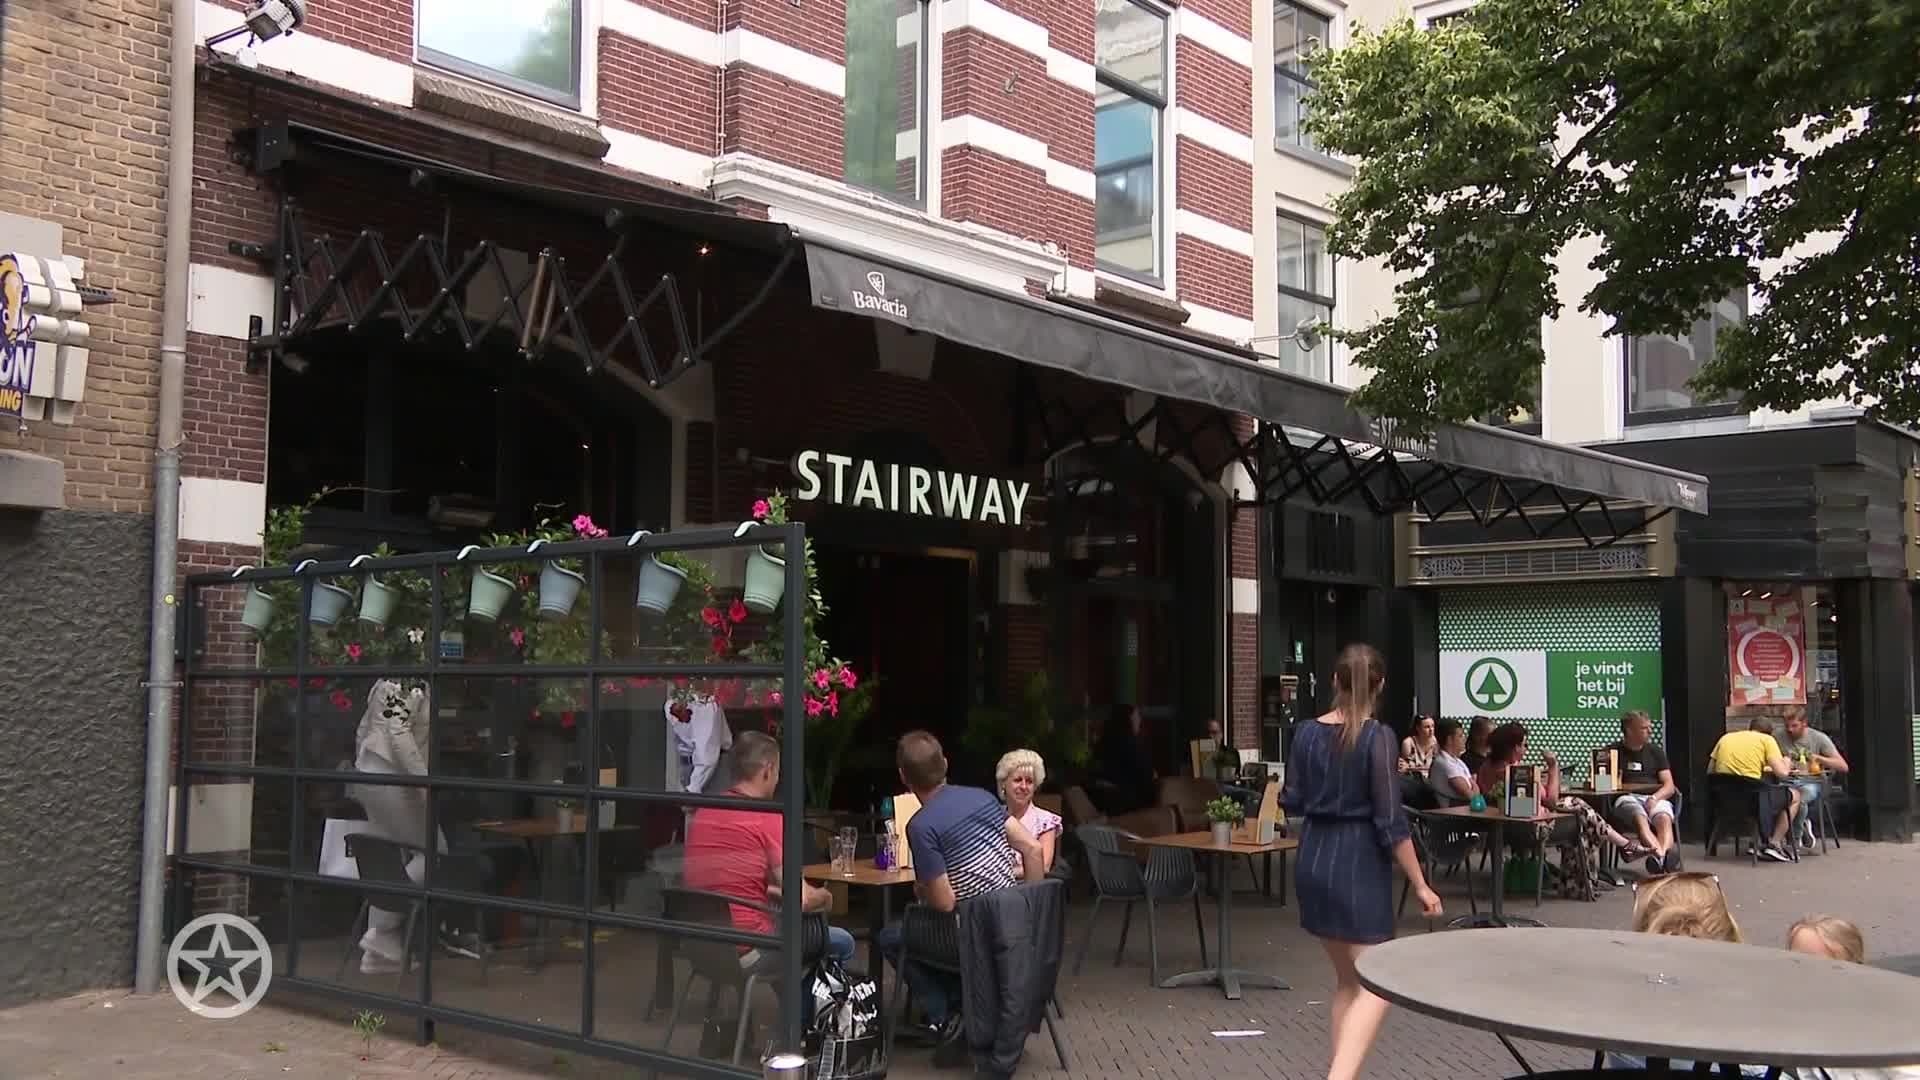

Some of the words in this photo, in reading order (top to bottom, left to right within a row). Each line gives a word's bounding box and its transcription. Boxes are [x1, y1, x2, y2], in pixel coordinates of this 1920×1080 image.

[852, 291, 908, 318] Bavaria
[797, 449, 1030, 526] STAIRWAY
[1574, 661, 1590, 678] je
[1593, 661, 1634, 675] vindt
[1576, 678, 1603, 692] het
[1606, 678, 1625, 695] bij
[1577, 695, 1619, 709] SPAR
